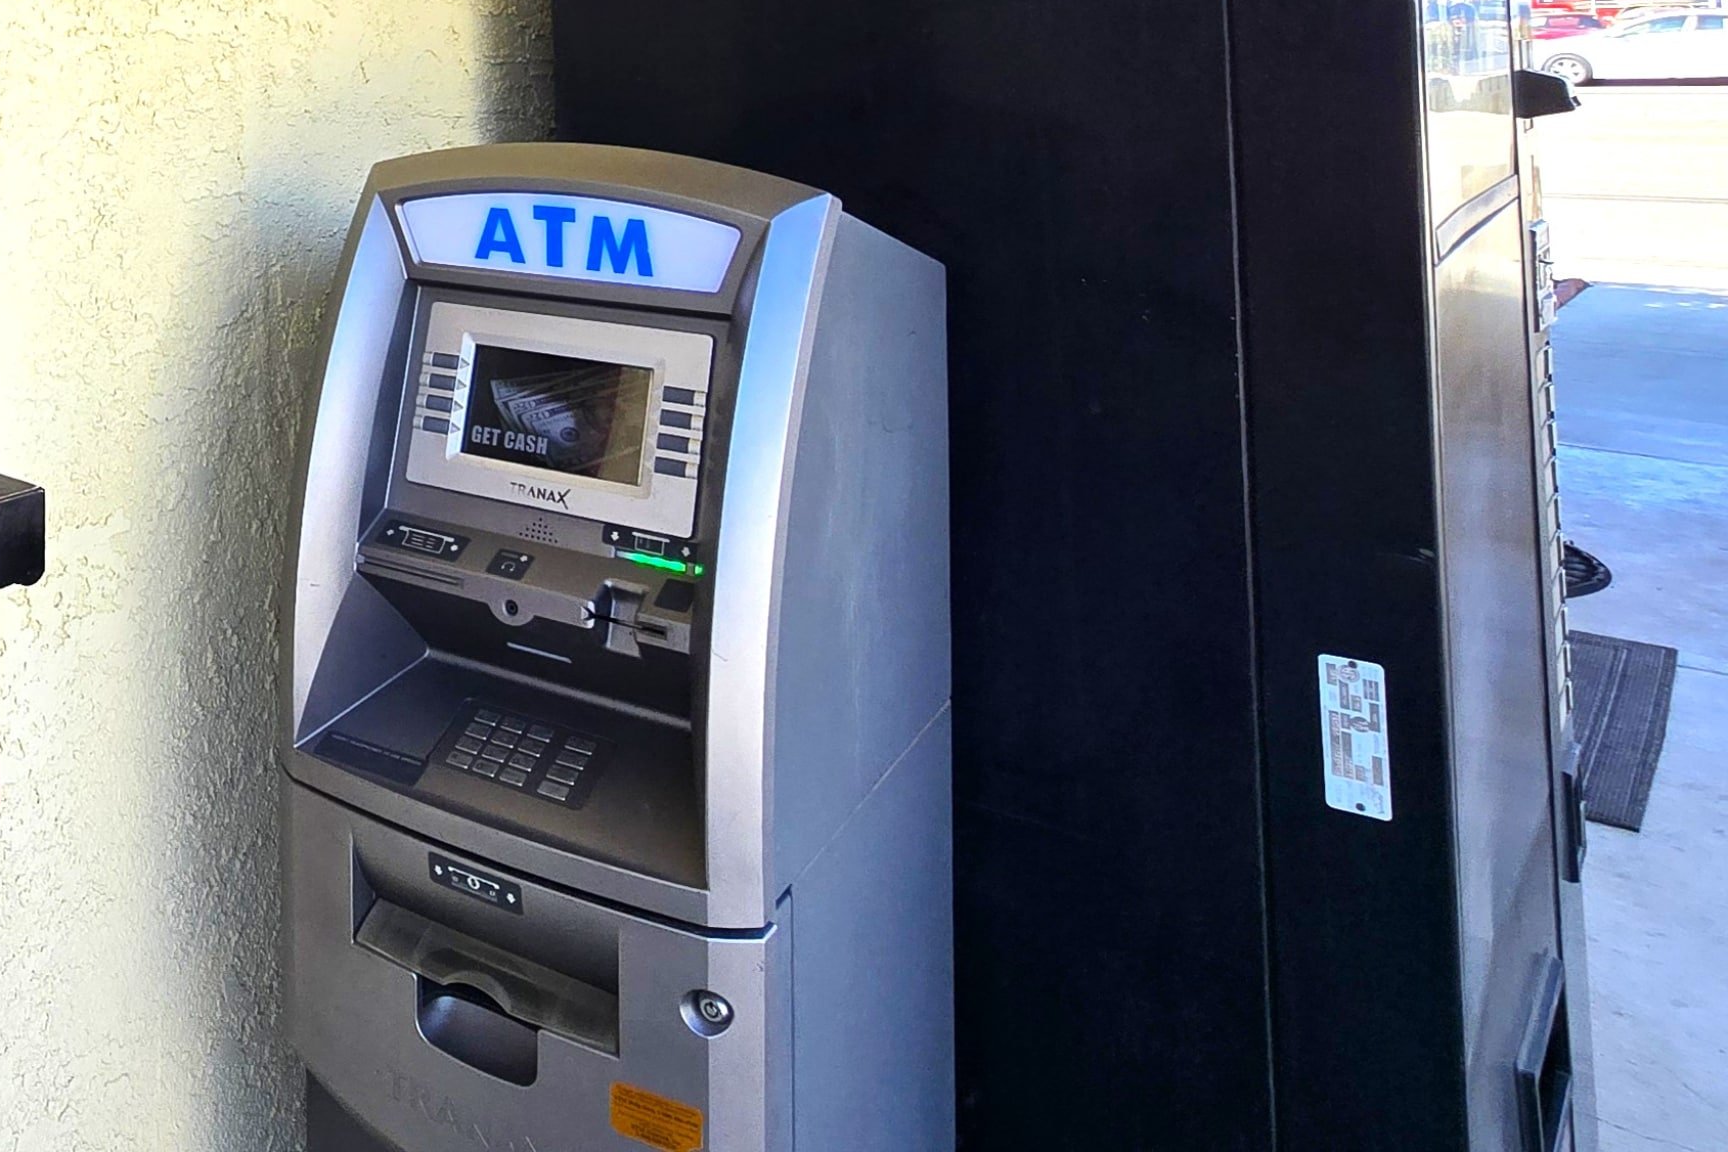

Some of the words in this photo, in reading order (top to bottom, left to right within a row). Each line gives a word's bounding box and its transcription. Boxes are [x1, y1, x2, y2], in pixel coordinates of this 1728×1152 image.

[474, 204, 654, 278] ATM
[471, 425, 502, 446] GET
[503, 430, 549, 456] CASH
[509, 481, 572, 510] TRANAX
